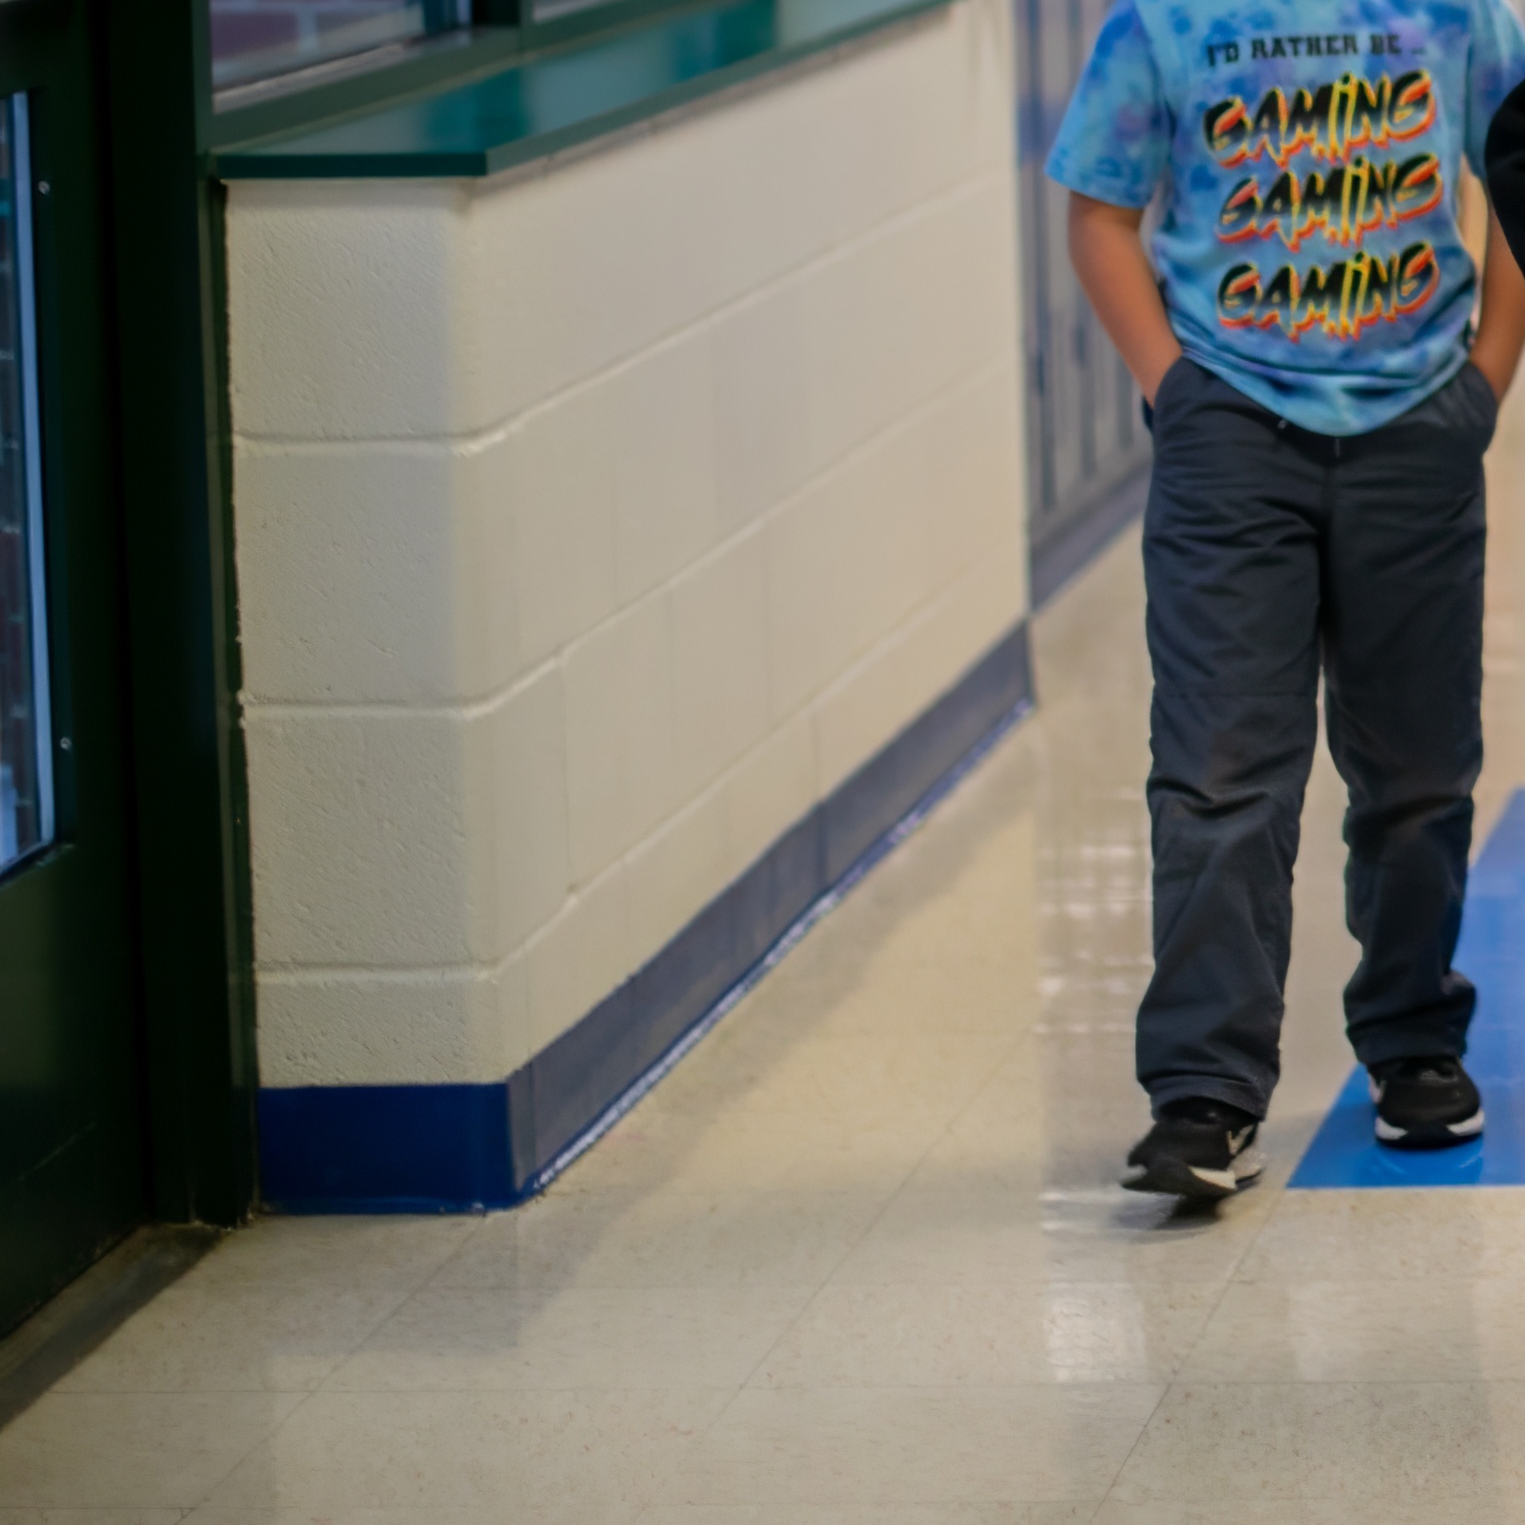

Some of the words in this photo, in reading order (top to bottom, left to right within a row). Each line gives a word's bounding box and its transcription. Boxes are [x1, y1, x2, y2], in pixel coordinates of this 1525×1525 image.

[1207, 44, 1240, 66] I'D
[1251, 33, 1358, 59] RATHER
[1369, 33, 1402, 54] BE
[1203, 69, 1436, 170] GAMING
[1215, 153, 1444, 253] GAMING
[1217, 241, 1440, 343] GAMING
